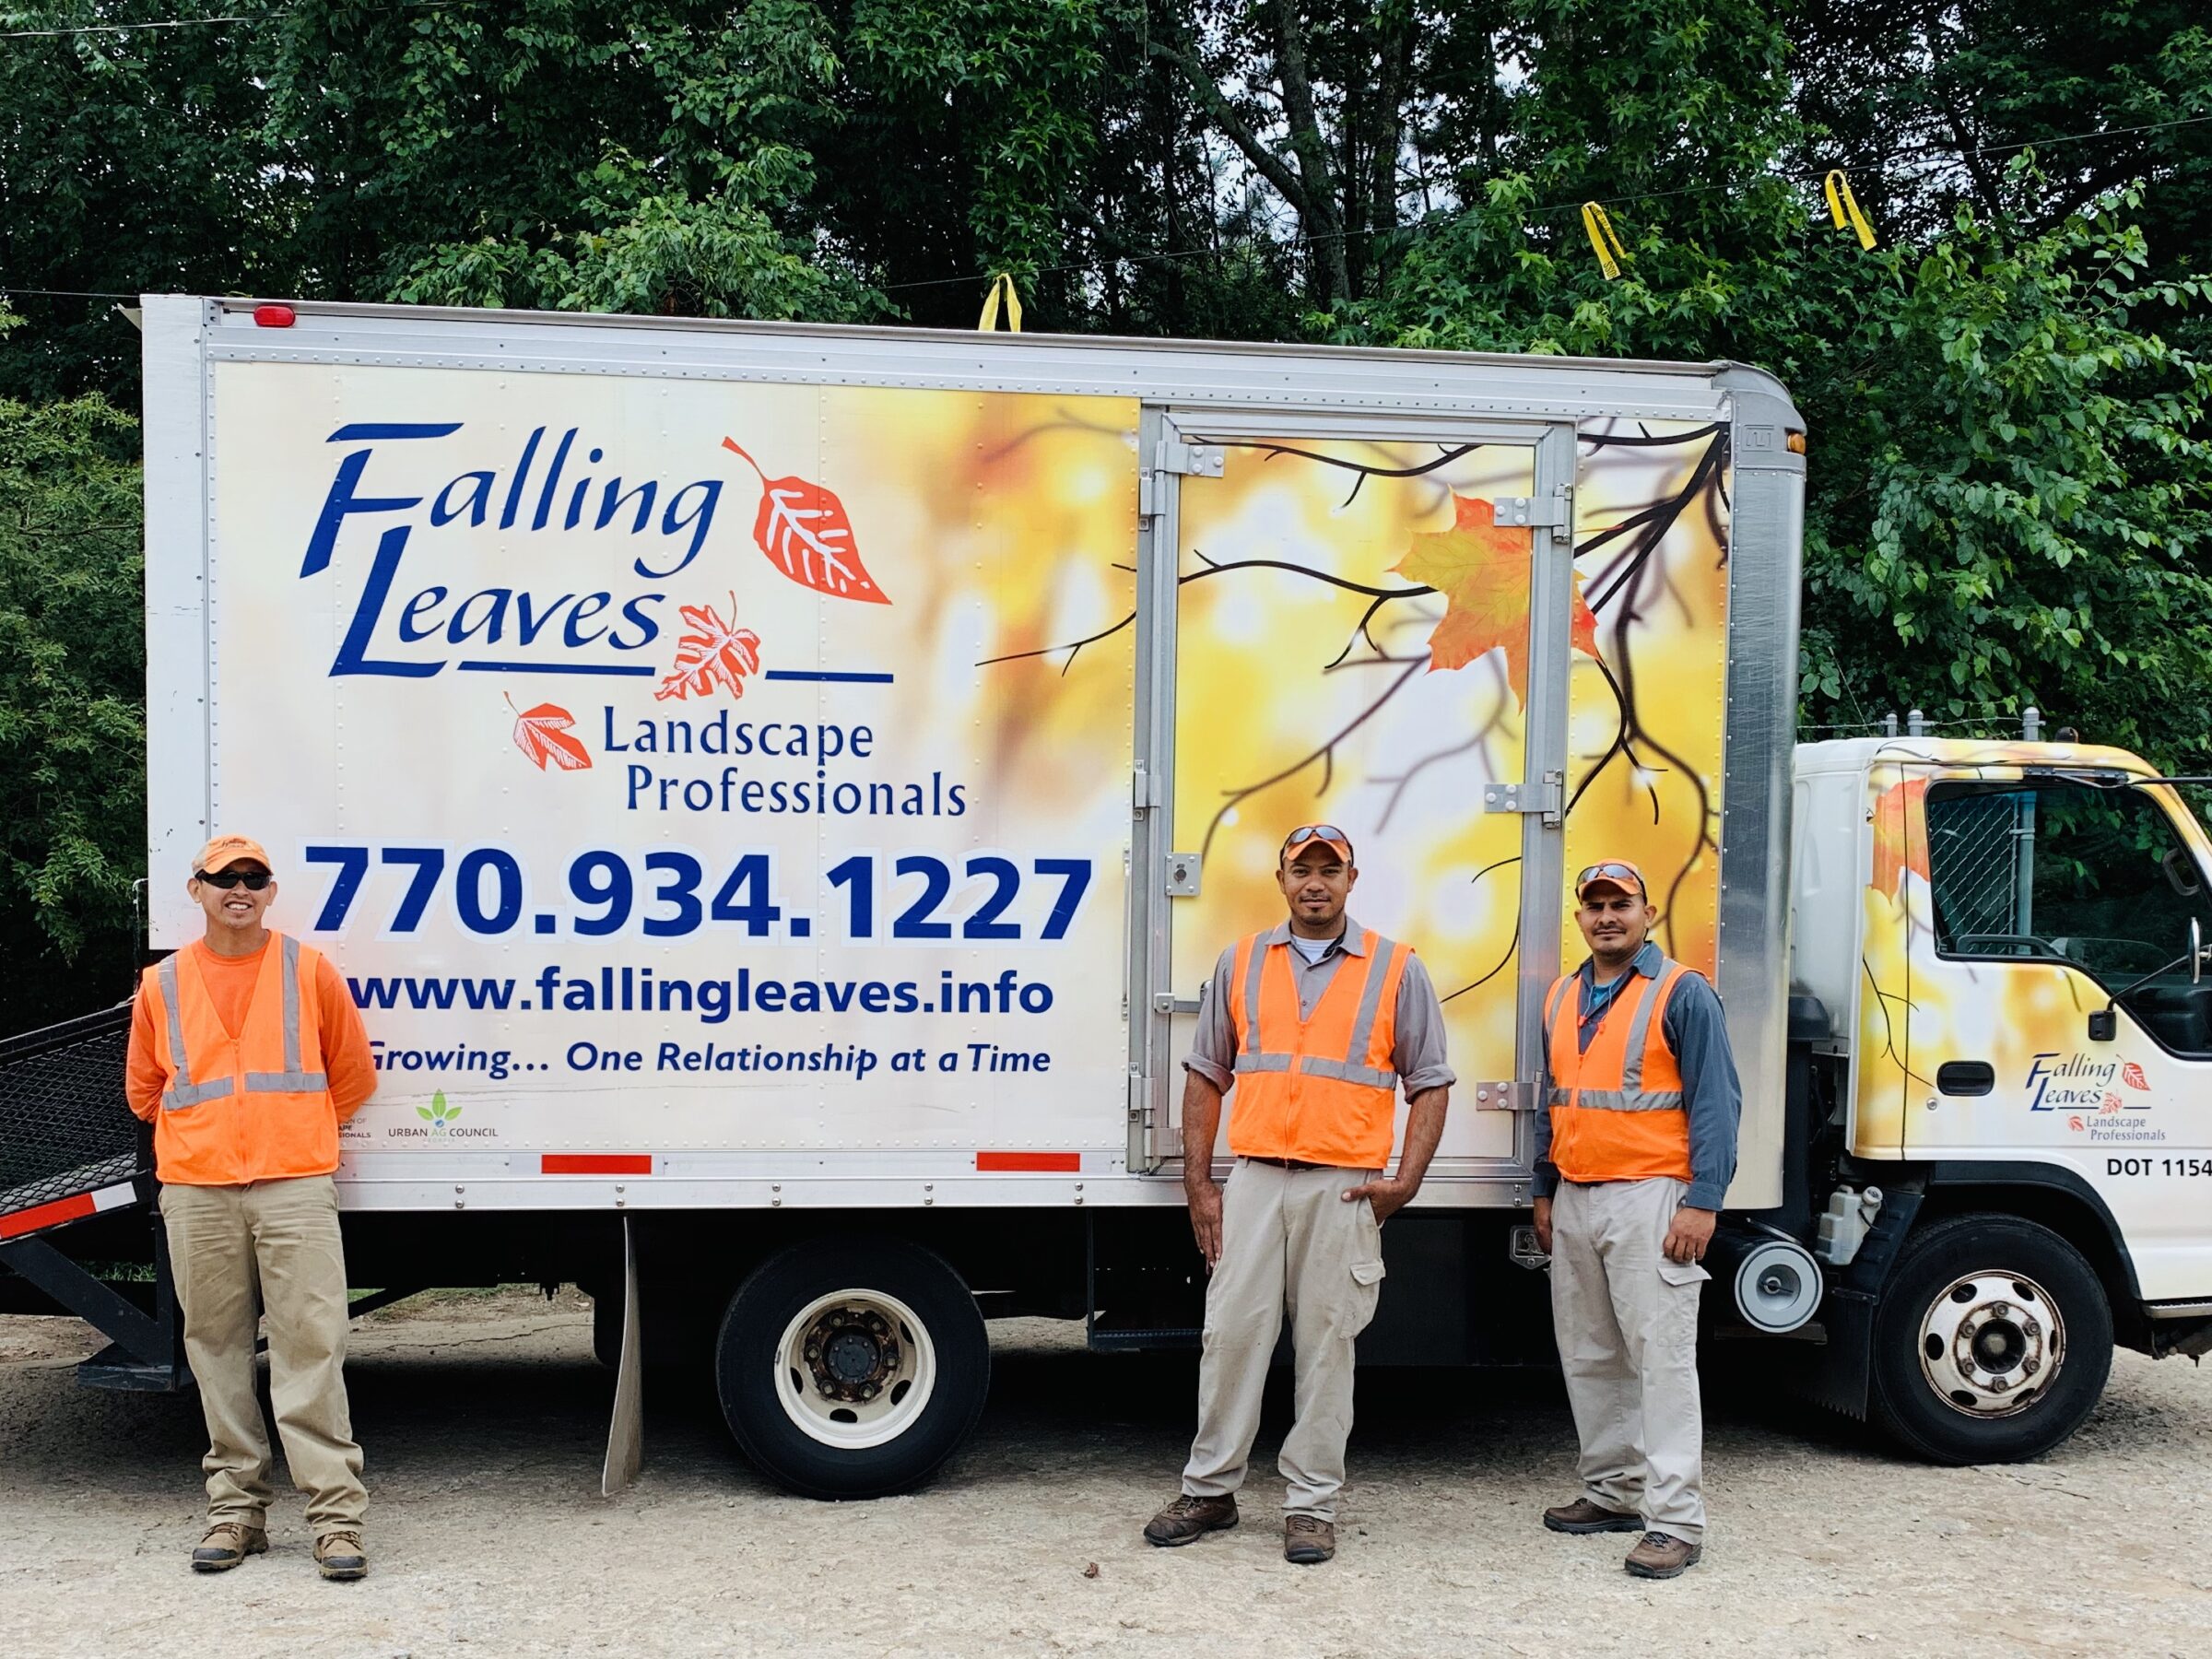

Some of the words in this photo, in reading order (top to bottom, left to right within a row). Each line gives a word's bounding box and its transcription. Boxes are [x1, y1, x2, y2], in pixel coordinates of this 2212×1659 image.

[300, 422, 724, 579] Falling
[328, 524, 666, 677] Leaves
[604, 706, 874, 766] Landscape
[627, 764, 967, 817] Professionals
[305, 846, 1093, 941] 770.934.1227
[347, 965, 1054, 1024] www.fallingleaves.info
[566, 1041, 643, 1072] One
[657, 1041, 878, 1081] Relationship
[890, 1049, 926, 1073] at
[938, 1053, 959, 1073] a
[967, 1042, 1051, 1073] Time
[2025, 1053, 2117, 1088] Falling
[2030, 1077, 2103, 1112] Leaves
[388, 1127, 429, 1137] URBAN
[430, 1127, 447, 1137] AG
[449, 1127, 500, 1137] COUNCIL
[2086, 1115, 2147, 1128] Landscape
[2090, 1129, 2166, 1141] Professionals
[2107, 1158, 2153, 1176] DOT
[2161, 1159, 2212, 1177] 1154
